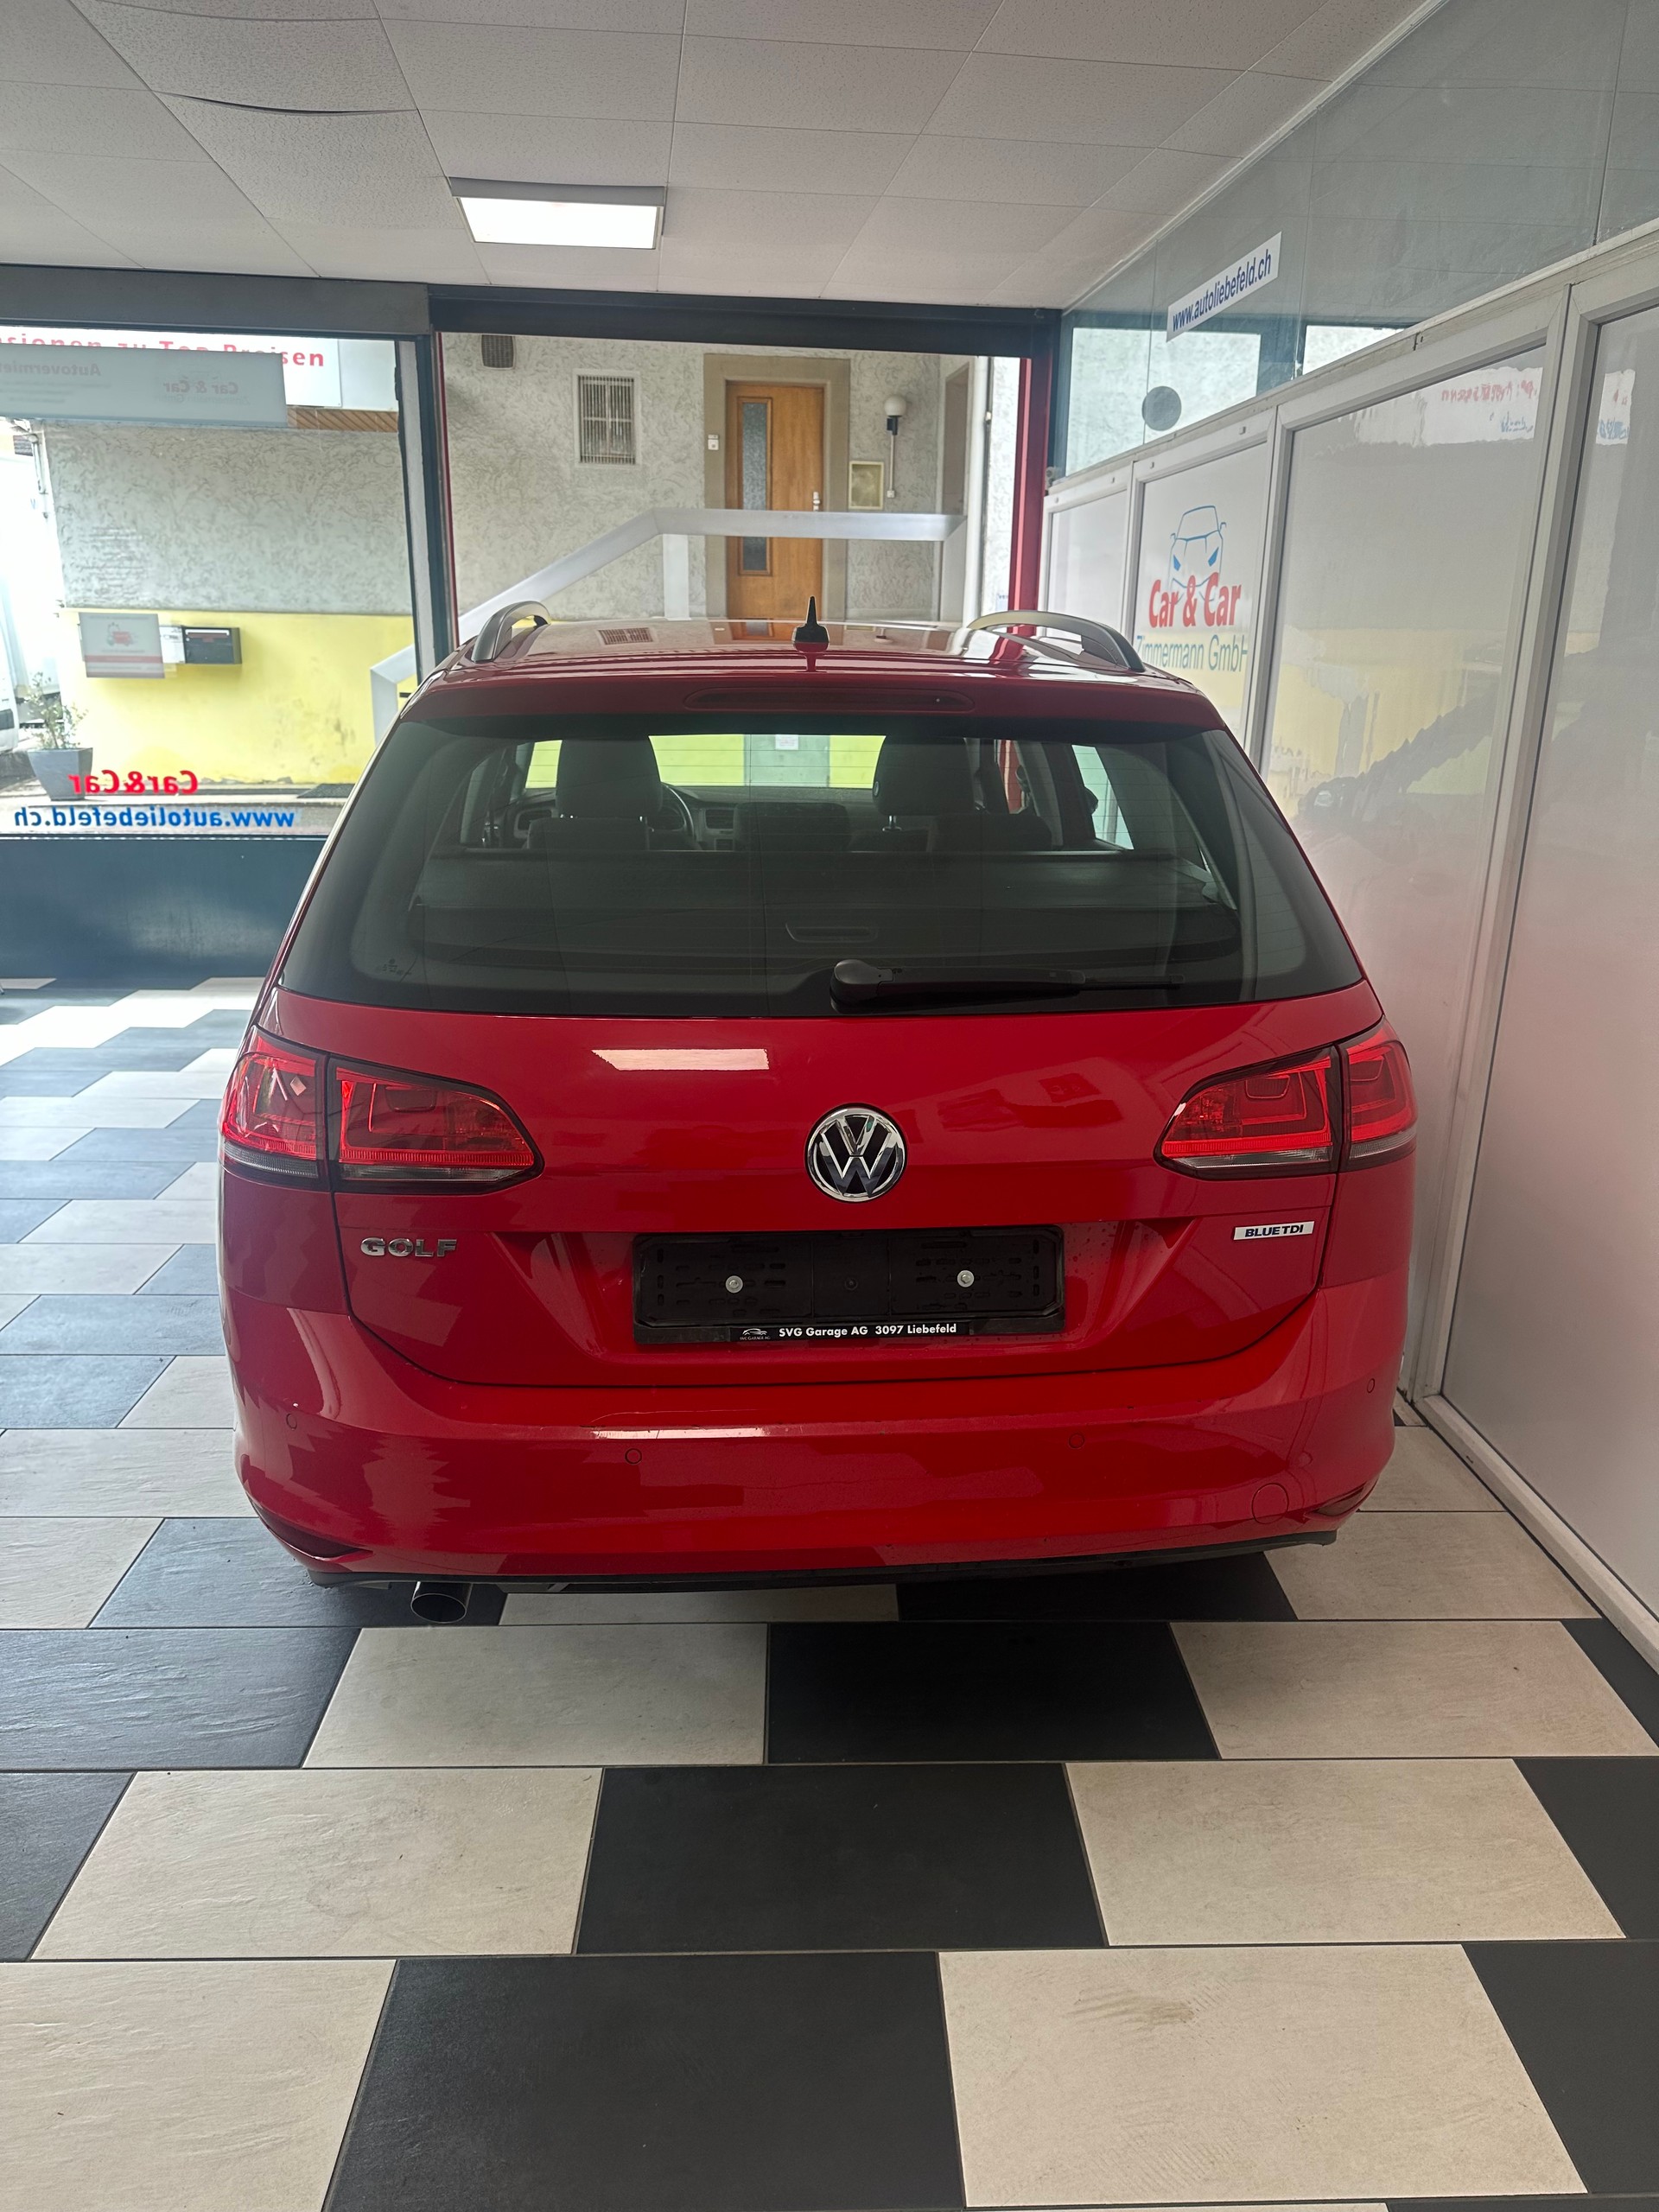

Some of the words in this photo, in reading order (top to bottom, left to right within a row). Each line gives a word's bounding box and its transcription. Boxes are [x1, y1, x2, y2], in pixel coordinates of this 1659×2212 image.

[1173, 248, 1271, 332] www.autoliebefeld.ch
[1149, 579, 1179, 628] Car
[1182, 575, 1198, 627] &
[1204, 571, 1242, 627] Car
[360, 1237, 457, 1257] GOLF
[779, 1327, 803, 1338] SVG
[805, 1326, 848, 1338] Garage
[851, 1325, 868, 1336] AG
[874, 1325, 904, 1335] 3097
[907, 1324, 957, 1335] Liebefeld
